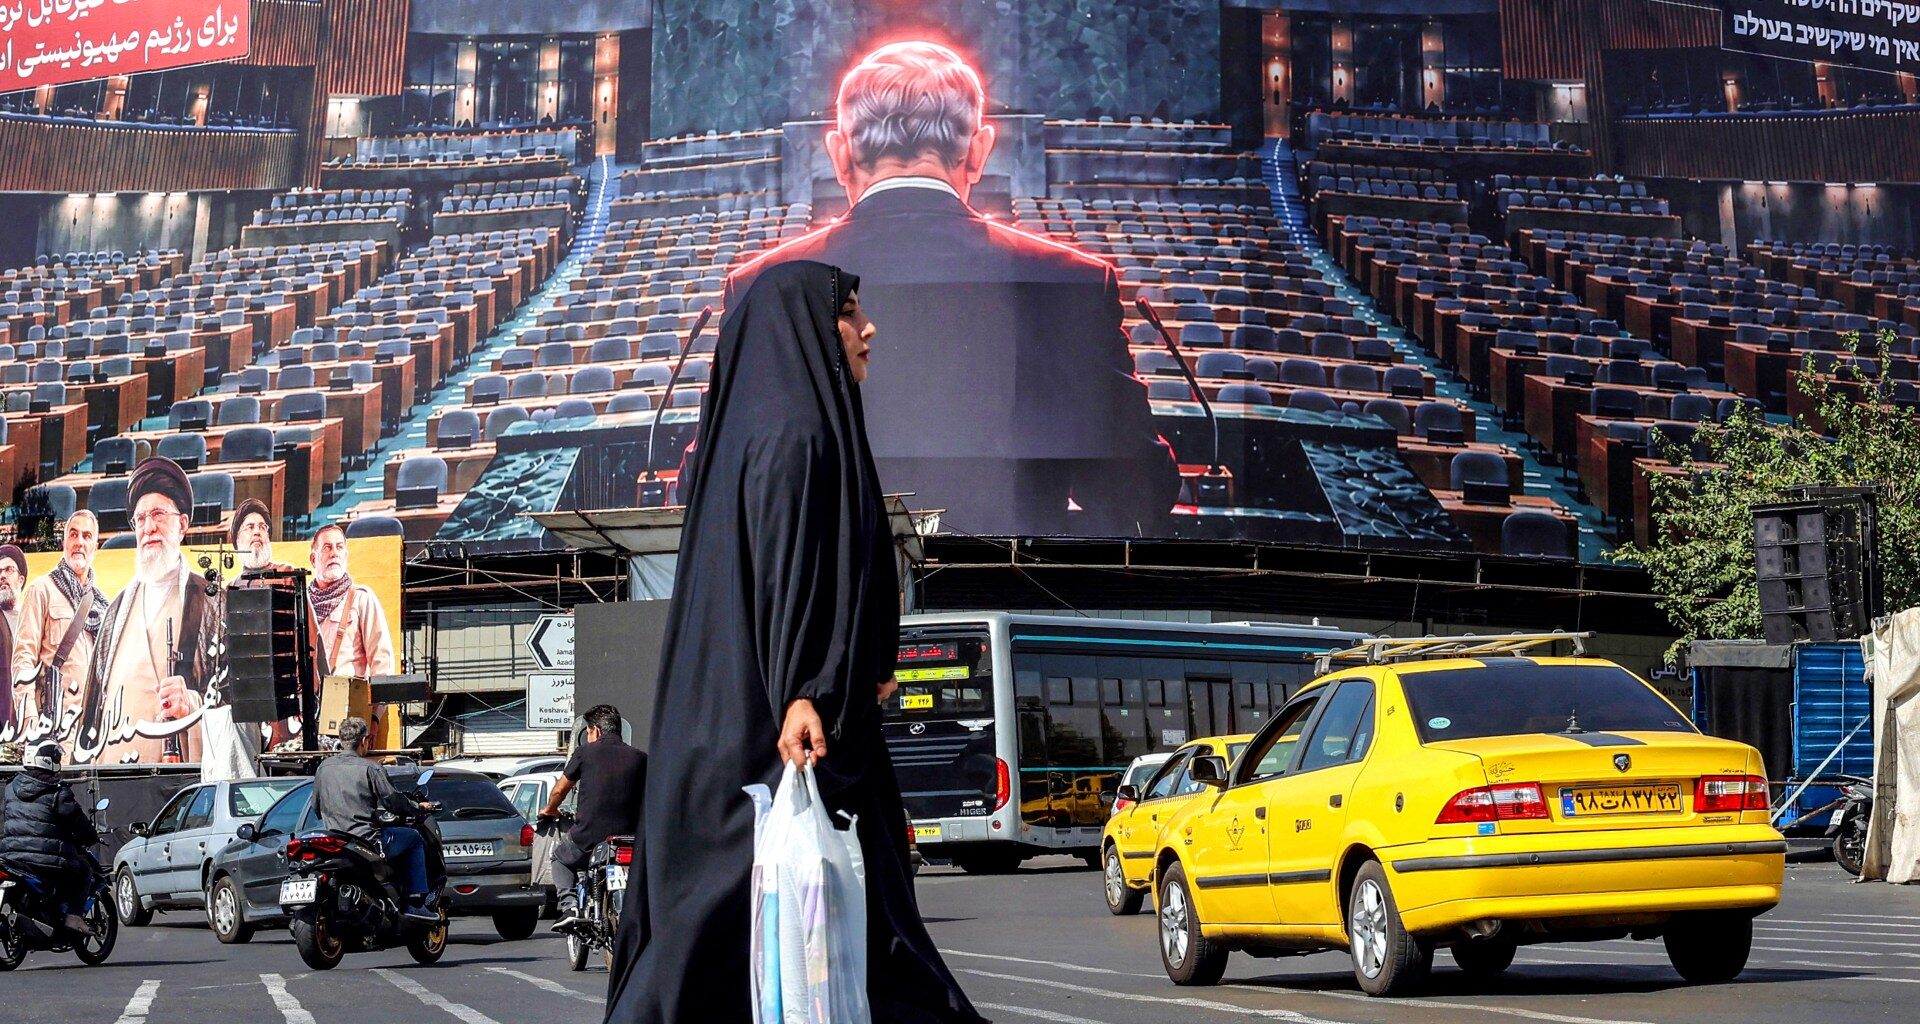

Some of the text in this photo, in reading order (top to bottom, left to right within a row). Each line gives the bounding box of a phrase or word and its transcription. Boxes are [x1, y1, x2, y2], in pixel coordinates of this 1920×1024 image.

[144, 15, 192, 64] رژیم
[197, 5, 239, 47] برای
[1733, 10, 1920, 64] אין מי שיקשיב בעולם
[16, 30, 141, 78] صهیونیستی
